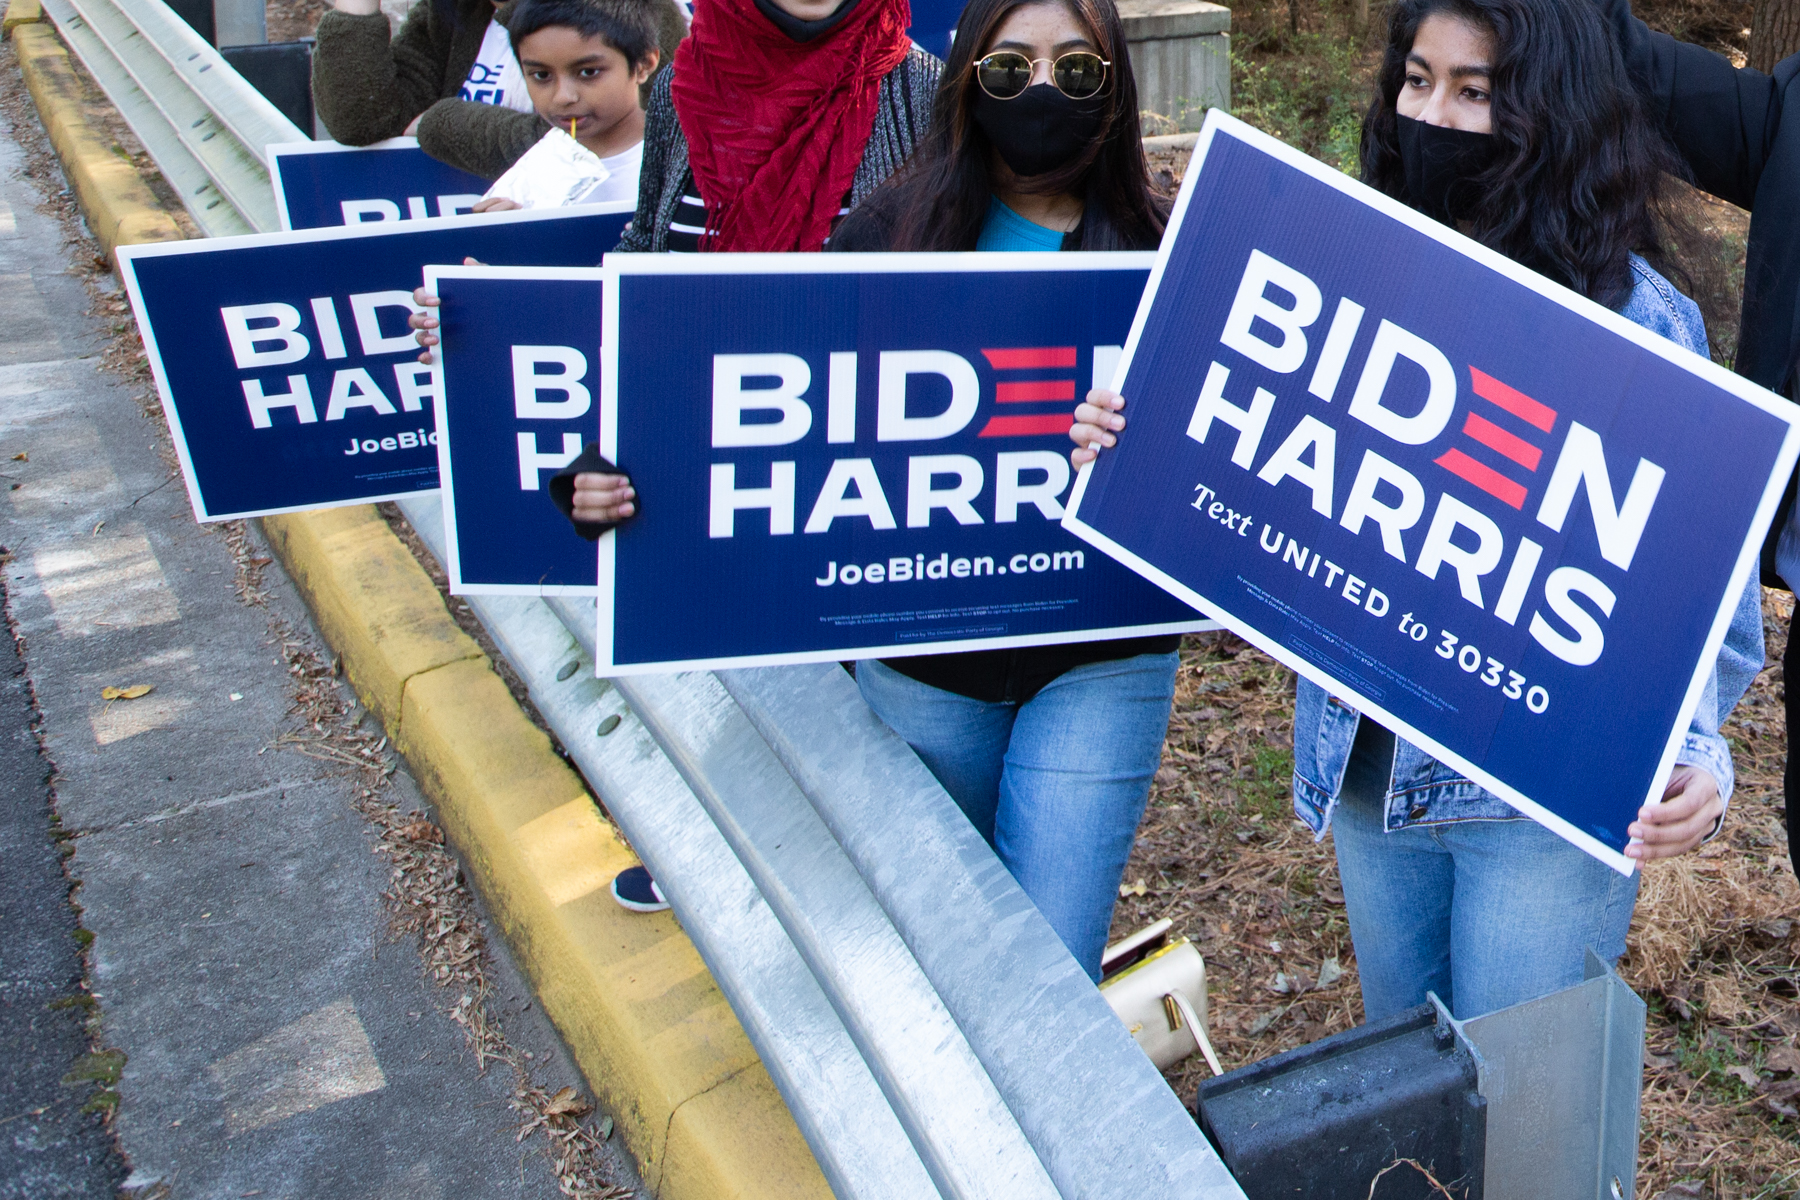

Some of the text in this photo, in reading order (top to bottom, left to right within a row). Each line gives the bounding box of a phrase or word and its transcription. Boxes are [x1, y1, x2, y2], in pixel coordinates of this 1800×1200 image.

[220, 290, 429, 369] BID
[1219, 248, 1667, 572] BIDEN
[709, 450, 1071, 538] HARR
[1185, 360, 1617, 666] HARRIS
[816, 550, 1084, 586] JoeBiden.com
[1190, 483, 1550, 714] Text UNITED to 30330
[1321, 633, 1335, 643] HELP
[1360, 657, 1374, 667] STOP
